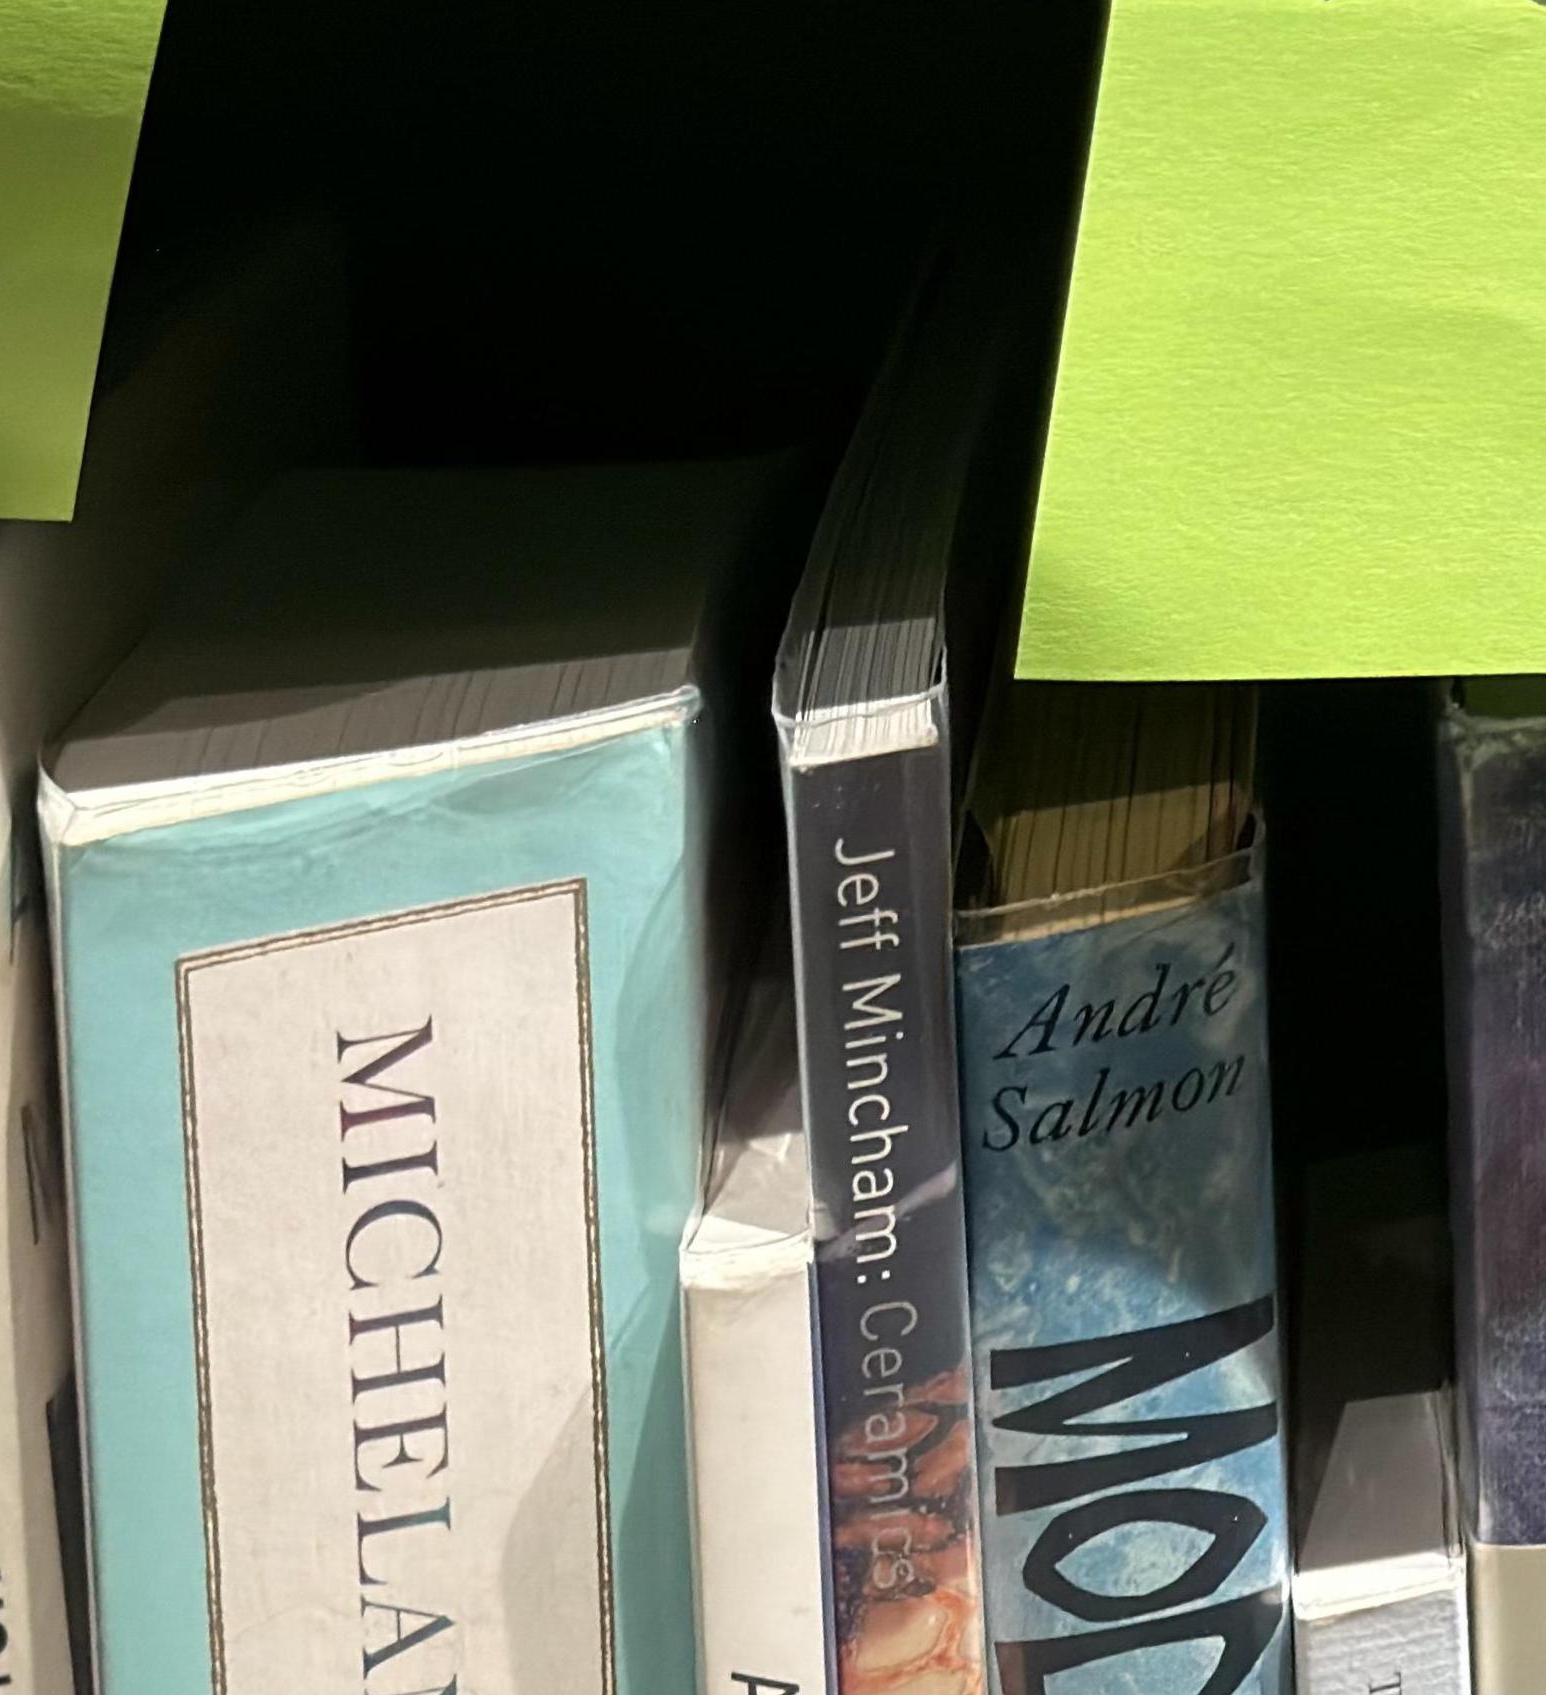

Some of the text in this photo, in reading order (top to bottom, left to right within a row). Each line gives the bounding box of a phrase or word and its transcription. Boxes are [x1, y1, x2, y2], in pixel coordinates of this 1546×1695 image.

[992, 942, 1238, 1061] André
[982, 1055, 1245, 1153] Salmon
[834, 839, 917, 1591] Jeff Mincham: Ceramics
